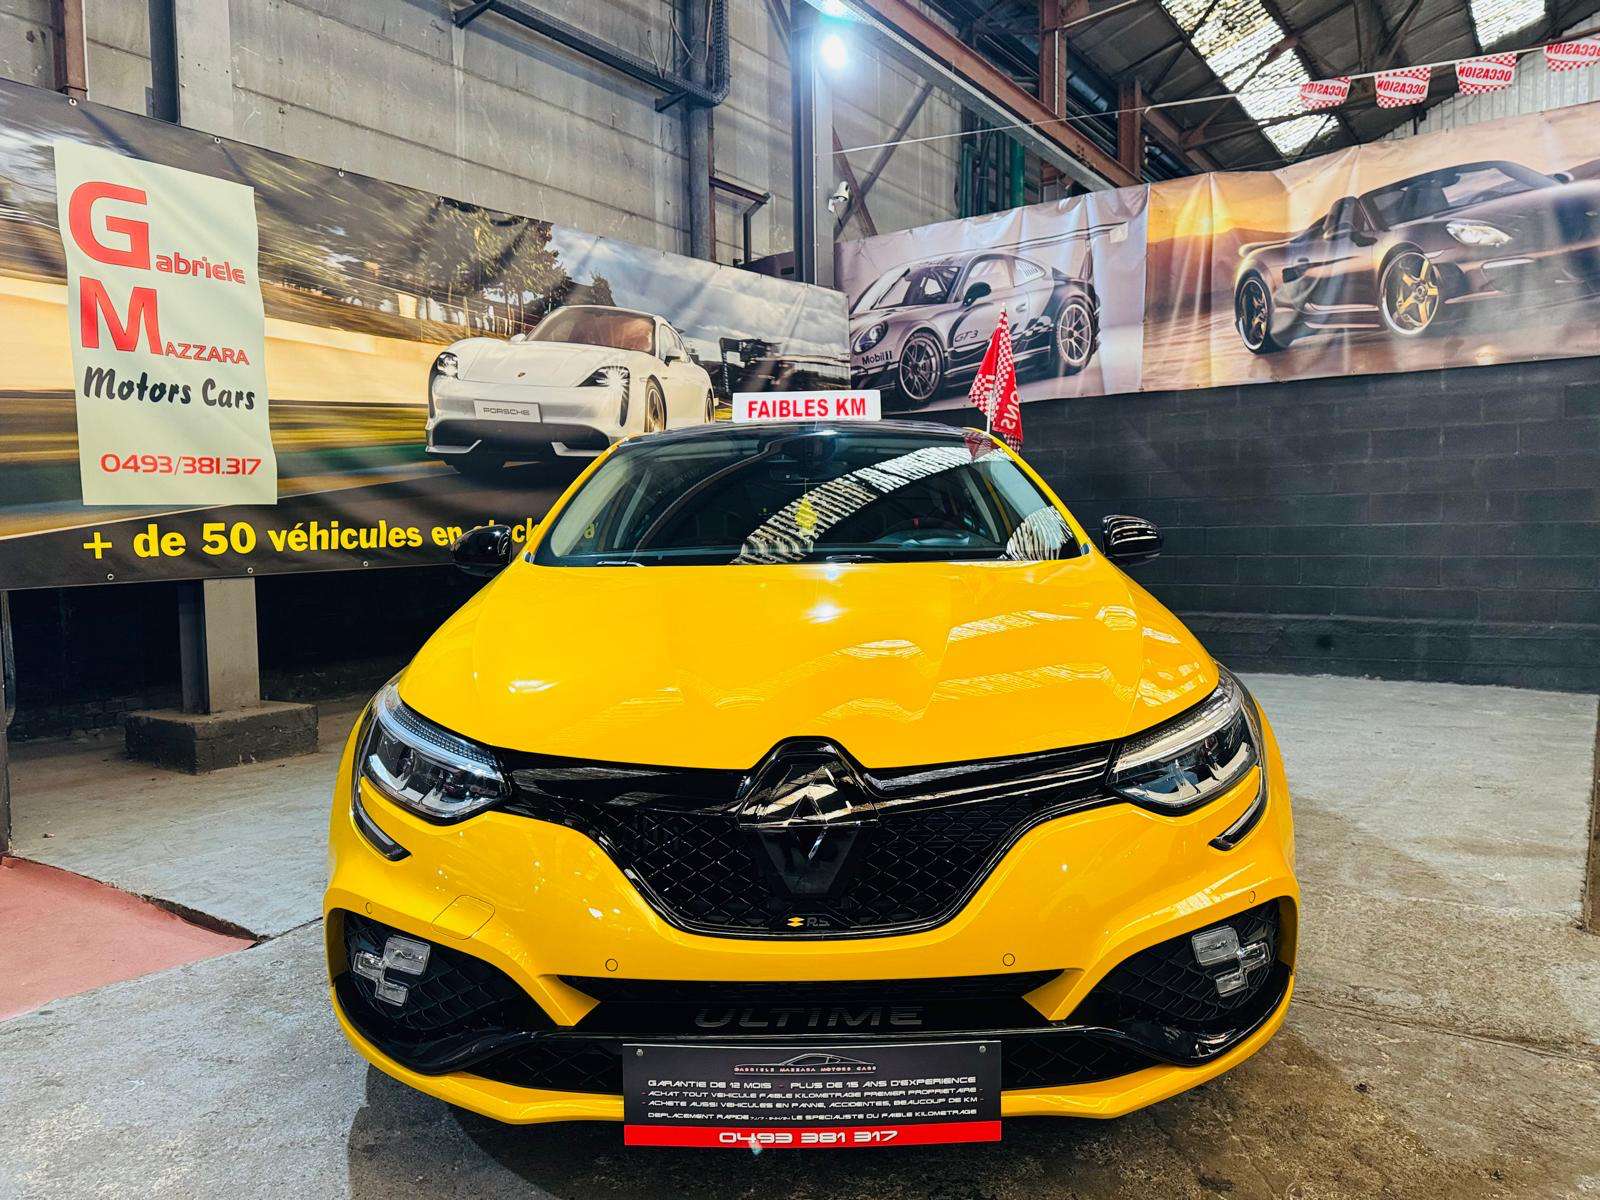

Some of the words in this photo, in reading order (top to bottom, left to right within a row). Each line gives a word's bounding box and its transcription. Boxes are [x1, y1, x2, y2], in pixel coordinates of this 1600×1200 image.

[68, 181, 247, 285] Gabriele
[955, 330, 979, 343] GT3
[83, 366, 192, 405] Motors
[201, 377, 255, 410] Cars
[483, 407, 530, 416] PORSCHE
[748, 399, 829, 418] FAIBLES
[836, 398, 866, 416] KM
[100, 453, 262, 476] 0493/381.317
[133, 523, 187, 558] de
[201, 521, 257, 555] 50
[267, 519, 423, 552] véhicules
[695, 1007, 923, 1027] ULTIME
[647, 1080, 707, 1089] GARANTIE
[710, 1081, 726, 1089] DE
[729, 1081, 741, 1089] 12
[826, 1081, 844, 1089] DE
[862, 1080, 887, 1088] ANS
[890, 1076, 977, 1087] D'EXPERIENCE
[794, 1091, 862, 1099] KILOMETRAGE
[863, 1089, 906, 1098] PREMIER
[908, 1087, 977, 1096] PROPRIETAIRE
[893, 1098, 947, 1106] BEAUCOUP
[647, 1112, 715, 1120] DEPLACEMENT
[915, 1108, 977, 1117] KILOMETRAGE
[719, 1132, 793, 1144] 0493
[801, 1132, 846, 1144] 381
[853, 1130, 898, 1143] 317
